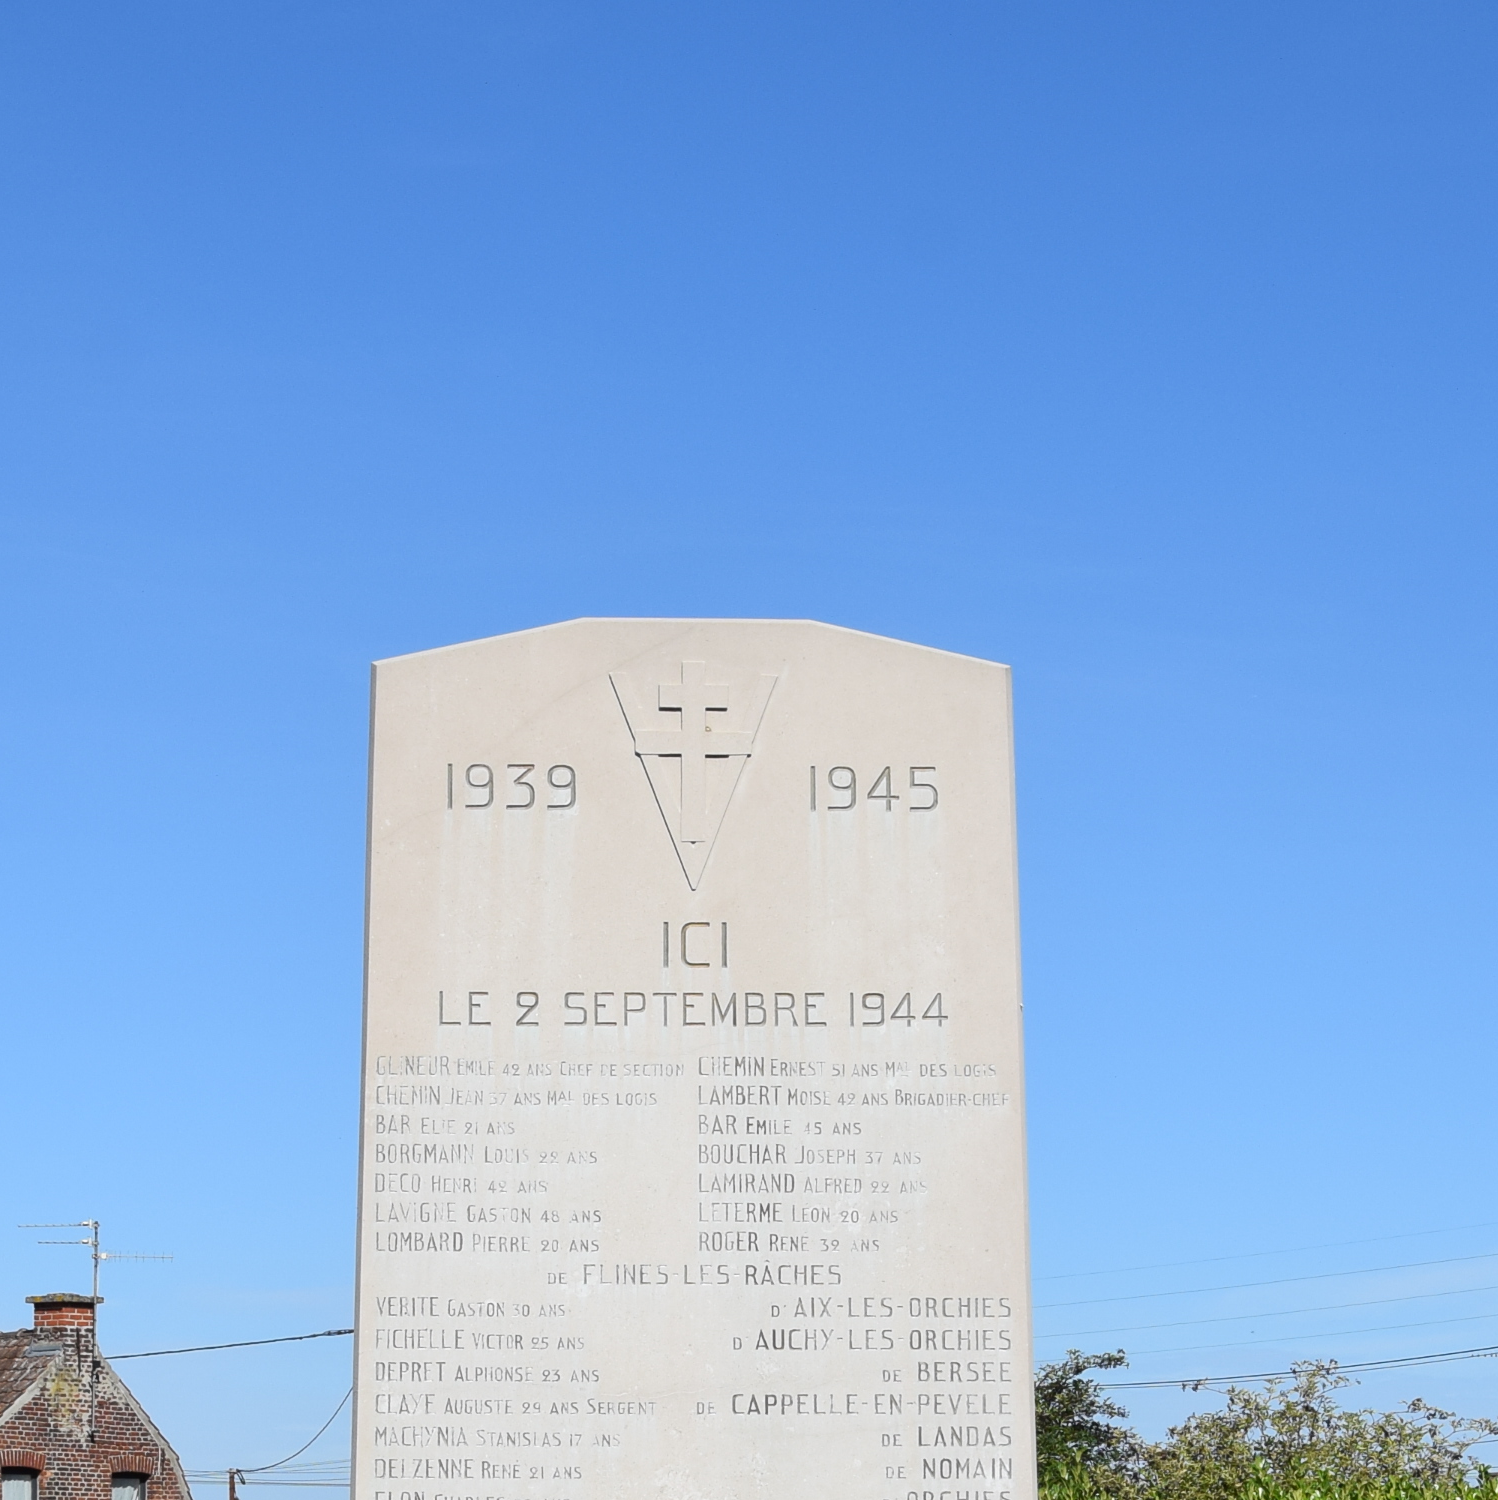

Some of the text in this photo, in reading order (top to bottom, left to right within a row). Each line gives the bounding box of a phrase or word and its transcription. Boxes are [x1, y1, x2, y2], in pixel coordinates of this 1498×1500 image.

[446, 763, 578, 811] 1939
[809, 766, 939, 811] 1945
[663, 922, 728, 968] ICI
[439, 991, 949, 1028] LE 2 SEPTEMBRE 1944
[457, 1060, 495, 1077] EMILE
[502, 1064, 520, 1077] 42
[527, 1063, 552, 1077] ANS
[560, 1061, 592, 1077] CHEF
[600, 1064, 618, 1077] DE
[623, 1064, 685, 1077] SECTION
[698, 1057, 997, 1077] CHEMIN ERNEST 51 ANS DES LOGIS
[375, 1086, 658, 1106] CHEMIN JEAN ANS DES LOGIS
[698, 1086, 782, 1106] LAMBERT
[838, 1094, 855, 1106] 42
[861, 1093, 889, 1106] ANS
[895, 1090, 1010, 1106] BRIGADIER-CHEF
[375, 1115, 410, 1135] BAR
[421, 1118, 456, 1134] ELIE
[486, 1122, 515, 1134] ANS
[699, 1115, 737, 1134] BAR
[746, 1118, 792, 1135] EMILE
[832, 1122, 862, 1135] ANS
[375, 1144, 598, 1164] BORGMANN LOUIS 22 ANS
[699, 1145, 921, 1164] BOUCHAR JOSEPH 37 ANS
[374, 1174, 548, 1194] DECO HENRI 42 ANS
[699, 1174, 928, 1193] LAMIRAND ALFRED 22 ANS
[375, 1203, 602, 1223] LAVIGNE GASTON 48 ANS
[699, 1203, 782, 1222] LETERME
[840, 1211, 859, 1223] 20
[869, 1211, 899, 1223] ANS
[376, 1232, 599, 1252] LOMBARD PIERRE 20 ANS
[699, 1232, 759, 1252] ROGER
[820, 1240, 840, 1252] 32
[851, 1239, 879, 1252] ANS
[548, 1272, 567, 1284] DE
[448, 1299, 505, 1317] GASTON
[513, 1305, 530, 1317] 30
[539, 1305, 566, 1317] ANS
[375, 1329, 465, 1349] FICHELLE
[472, 1333, 523, 1349] VICTOR
[531, 1338, 549, 1349] 25
[557, 1337, 584, 1350] ANS
[375, 1362, 1012, 1382] DEPRET ALPHONSE 23 ANS DE BERSEE
[375, 1394, 1011, 1415] CLAYE AUGUSTE 29 ANS SERGENT DE CAPPELLE-EN-PEVELE
[476, 1430, 561, 1447] STANISLAS
[569, 1434, 582, 1446] 17
[882, 1434, 902, 1446] DE
[918, 1426, 1011, 1447] LANDAS
[375, 1459, 473, 1479] DELZENNE
[529, 1467, 544, 1479] 21
[553, 1467, 582, 1479] ANS
[885, 1467, 906, 1479] DE
[923, 1459, 1012, 1480] NOMAIN
